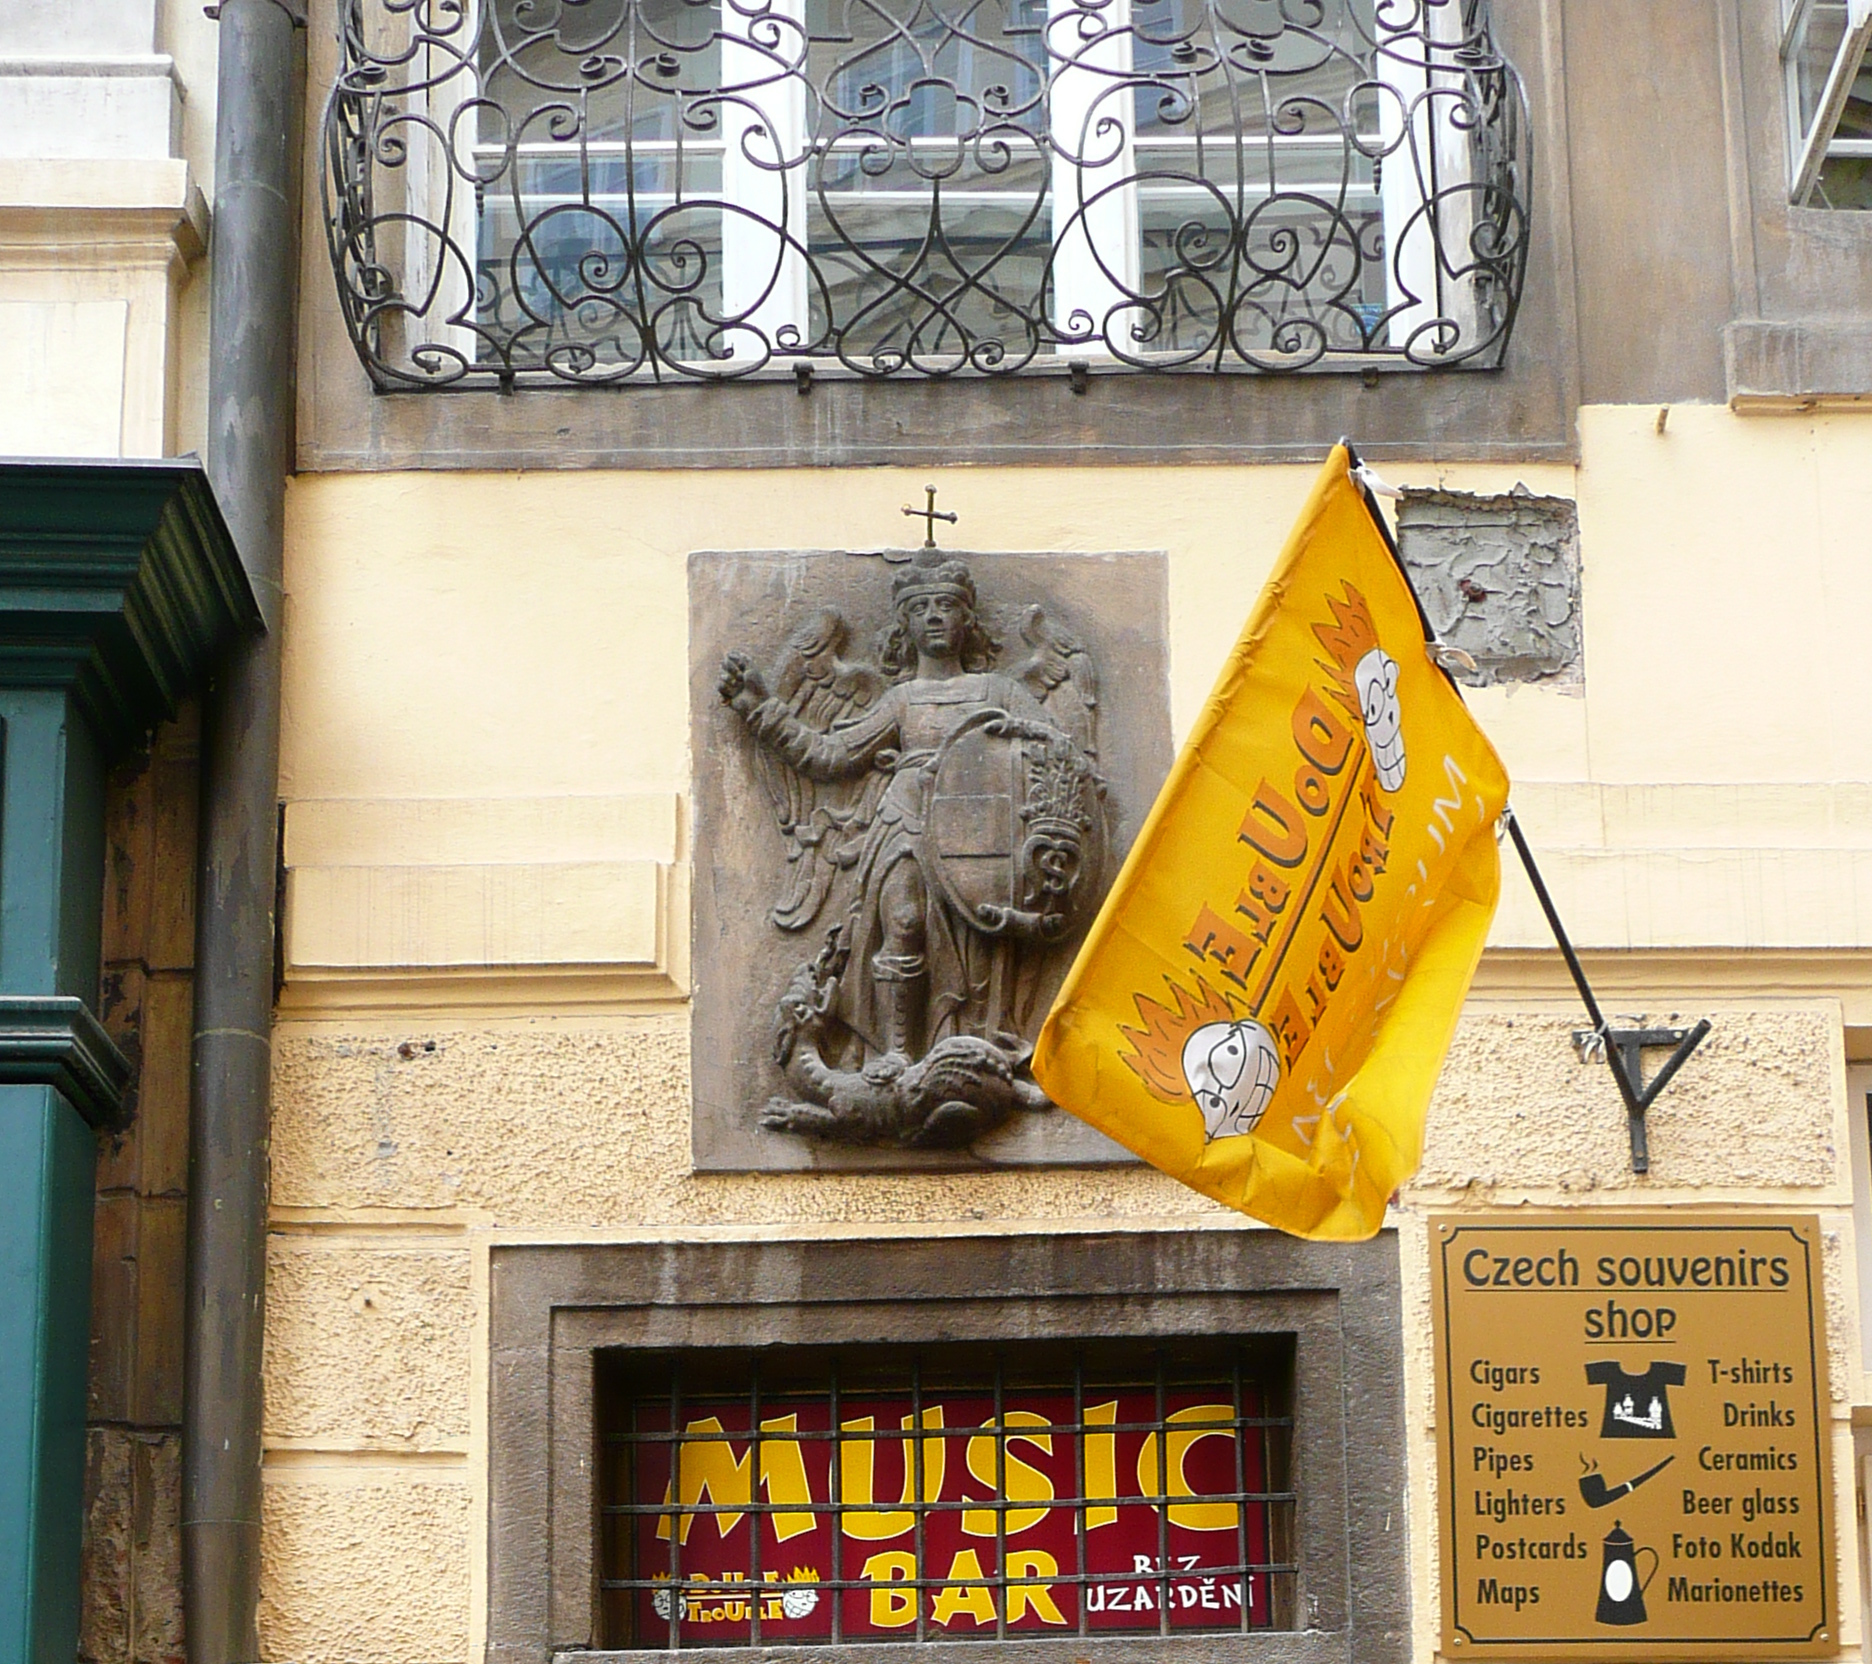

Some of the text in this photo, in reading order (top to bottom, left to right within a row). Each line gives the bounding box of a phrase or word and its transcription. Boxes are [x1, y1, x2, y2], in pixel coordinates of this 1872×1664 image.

[1463, 1248, 1790, 1287] Czech souvenirs
[1584, 1299, 1677, 1339] shop
[1470, 1360, 1540, 1391] Cigars
[1708, 1358, 1793, 1384] T-shirts
[1472, 1403, 1588, 1435] Cigarettes
[1724, 1402, 1795, 1427] Drinks
[655, 1400, 1240, 1546] MUSIC
[1473, 1447, 1534, 1479] Pipes
[1699, 1446, 1798, 1472] Ceramics
[1474, 1490, 1566, 1523] Lighters
[1683, 1488, 1800, 1521] Beer glass
[1476, 1532, 1588, 1560] Postcards
[1673, 1532, 1801, 1558] Foto Kodak
[1133, 1555, 1201, 1580] BZ
[860, 1548, 1067, 1628] BAR
[1477, 1578, 1540, 1611] Maps
[1668, 1576, 1804, 1603] Marionettes
